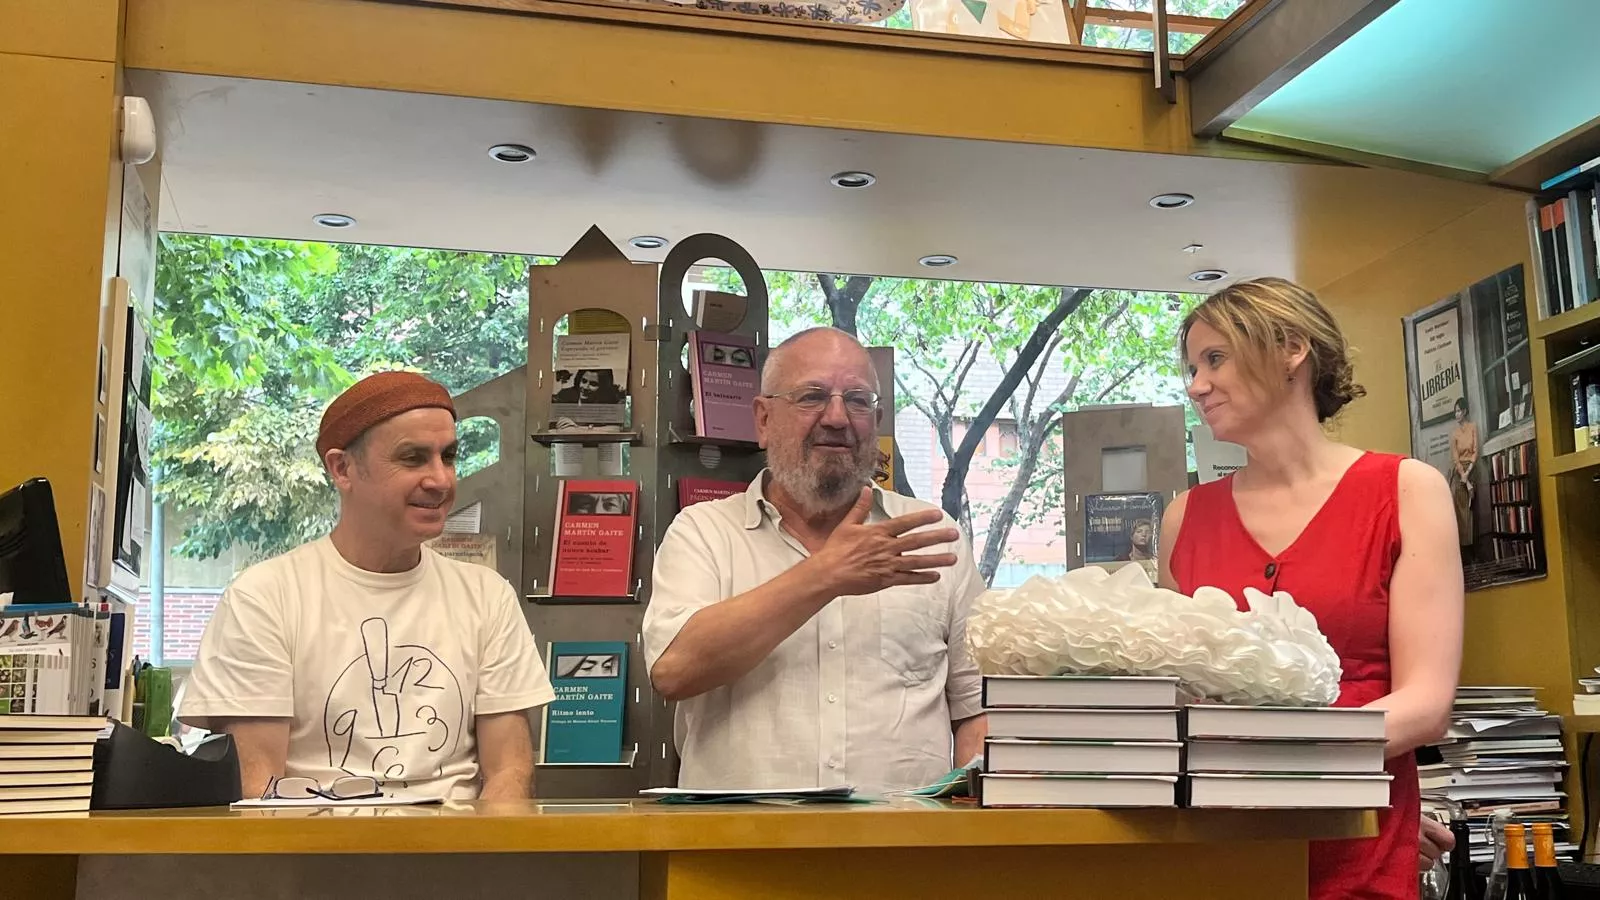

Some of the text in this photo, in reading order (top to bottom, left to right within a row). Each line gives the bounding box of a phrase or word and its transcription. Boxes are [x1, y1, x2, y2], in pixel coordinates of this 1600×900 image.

[1421, 361, 1461, 402] LIBRERÍA
[333, 708, 358, 768] 9
[416, 705, 449, 752] 3
